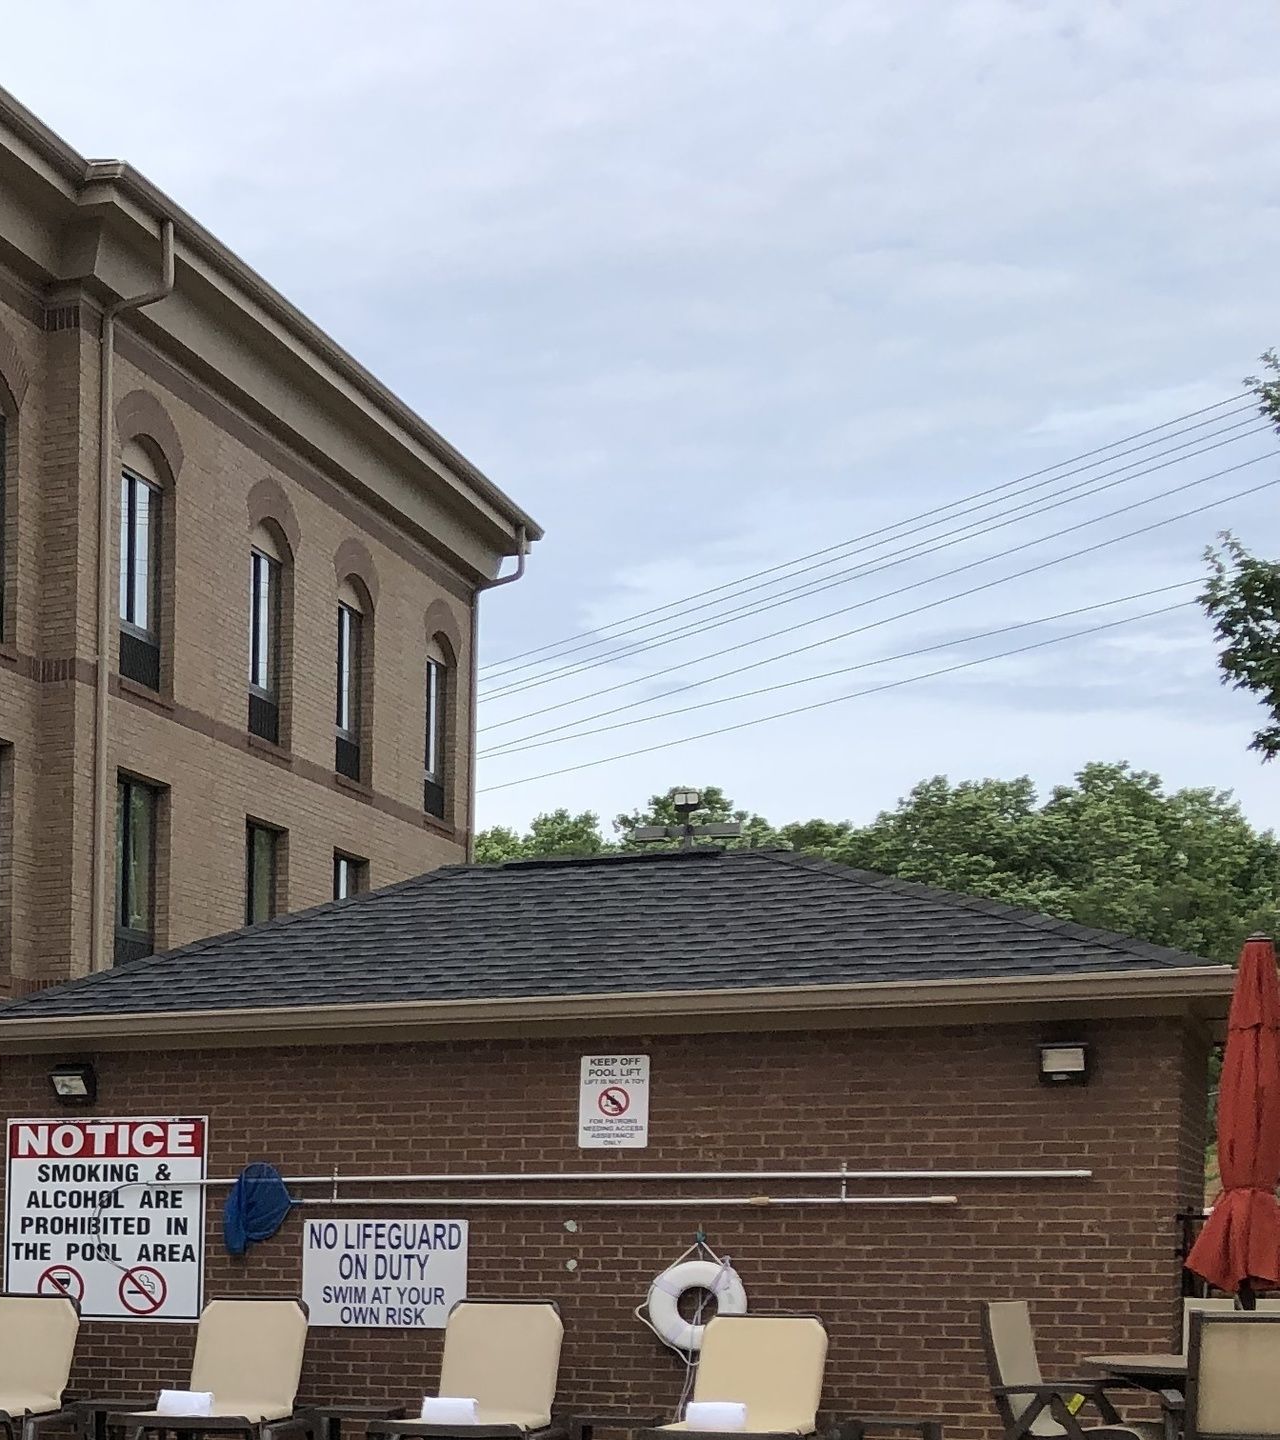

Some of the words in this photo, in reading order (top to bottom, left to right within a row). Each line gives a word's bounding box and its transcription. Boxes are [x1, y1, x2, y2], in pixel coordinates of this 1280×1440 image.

[590, 1057, 618, 1066] KEEP
[620, 1057, 641, 1066] OFF
[588, 1069, 616, 1077] POOL
[620, 1068, 642, 1077] LIFT
[17, 1123, 195, 1156] NOTICE
[37, 1163, 139, 1183] SMOKING
[155, 1163, 172, 1182] &
[26, 1190, 125, 1209] ALCOHOL
[139, 1190, 184, 1209] ARE
[20, 1216, 151, 1235] PROHIBITED
[166, 1217, 188, 1236] IN
[309, 1223, 338, 1250] NO
[344, 1223, 462, 1250] LIFEGUARD
[12, 1242, 52, 1261] THE
[66, 1243, 122, 1262] POOL
[136, 1243, 197, 1263] AREA
[339, 1253, 368, 1280] ON
[374, 1254, 430, 1281] DUTY
[322, 1285, 367, 1304] SWIM
[370, 1286, 392, 1305] AT
[396, 1287, 446, 1305] YOUR
[340, 1306, 380, 1325] OWN
[385, 1307, 426, 1326] RISK
